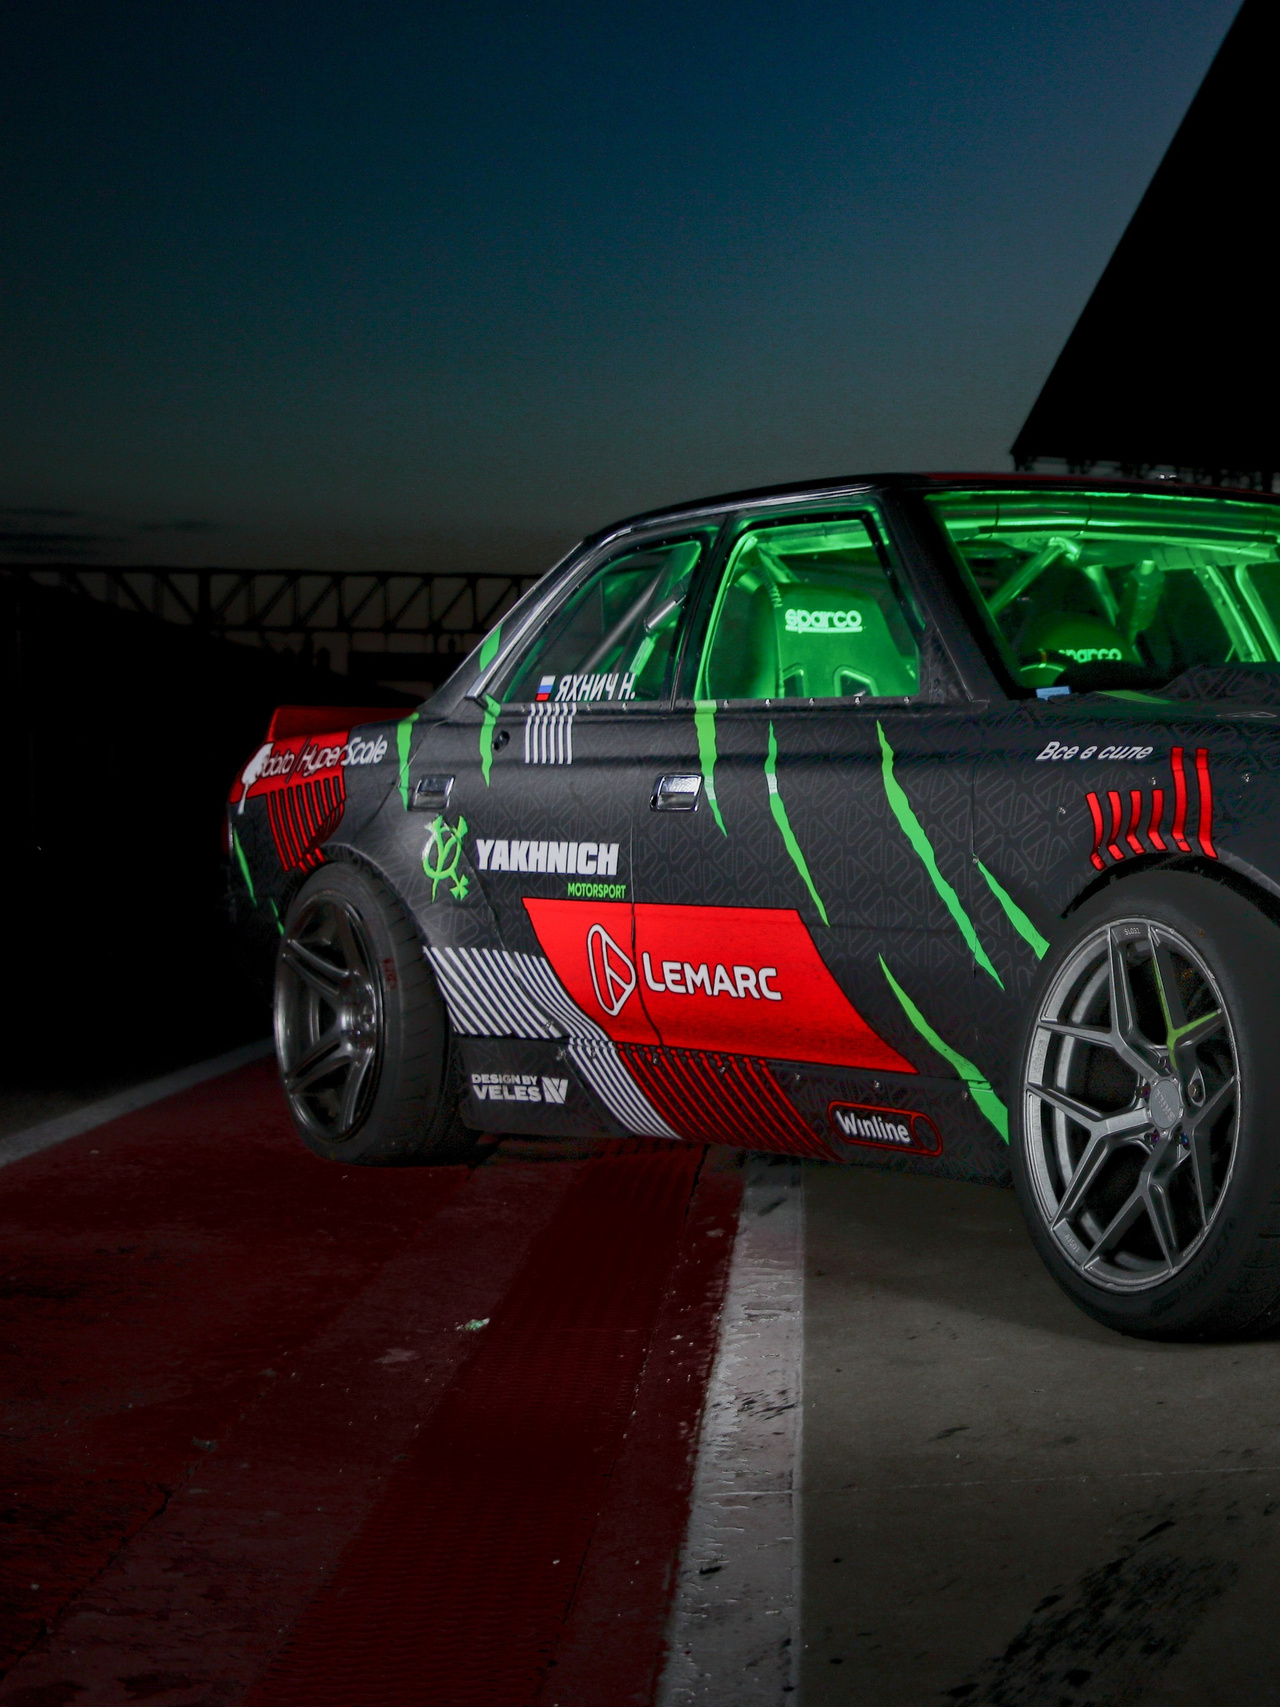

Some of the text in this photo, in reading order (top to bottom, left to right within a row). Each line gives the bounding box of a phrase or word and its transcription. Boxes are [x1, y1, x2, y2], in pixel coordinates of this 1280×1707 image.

[784, 608, 863, 634] sparco
[554, 672, 636, 701] ЯХНИЧ Н.
[1036, 741, 1153, 761] Все в силе
[476, 838, 620, 876] YAKHNICH
[567, 882, 627, 899] MOTORSPORT
[642, 951, 782, 1001] LEMARC
[471, 1073, 538, 1085] DESIGN BY
[472, 1084, 542, 1102] VELES
[835, 1110, 911, 1143] Winline
